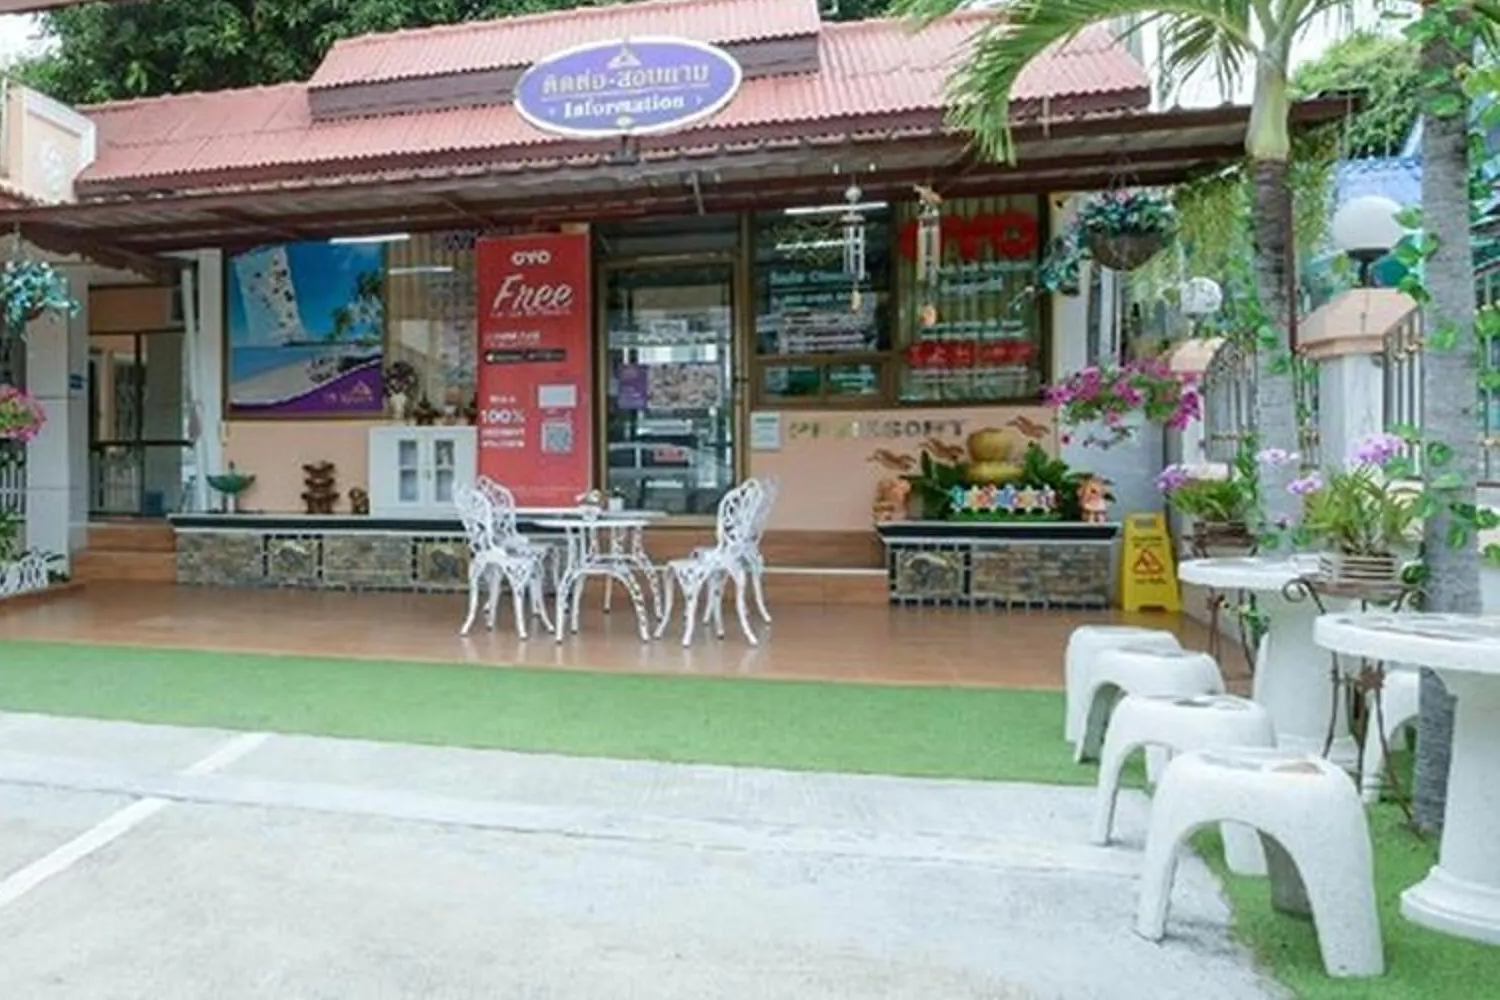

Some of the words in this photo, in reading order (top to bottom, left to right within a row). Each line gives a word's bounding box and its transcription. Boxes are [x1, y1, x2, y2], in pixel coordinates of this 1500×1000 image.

[563, 94, 685, 119] Information
[511, 250, 552, 267] OYO
[492, 273, 573, 310] Free
[480, 408, 526, 425] 100%
